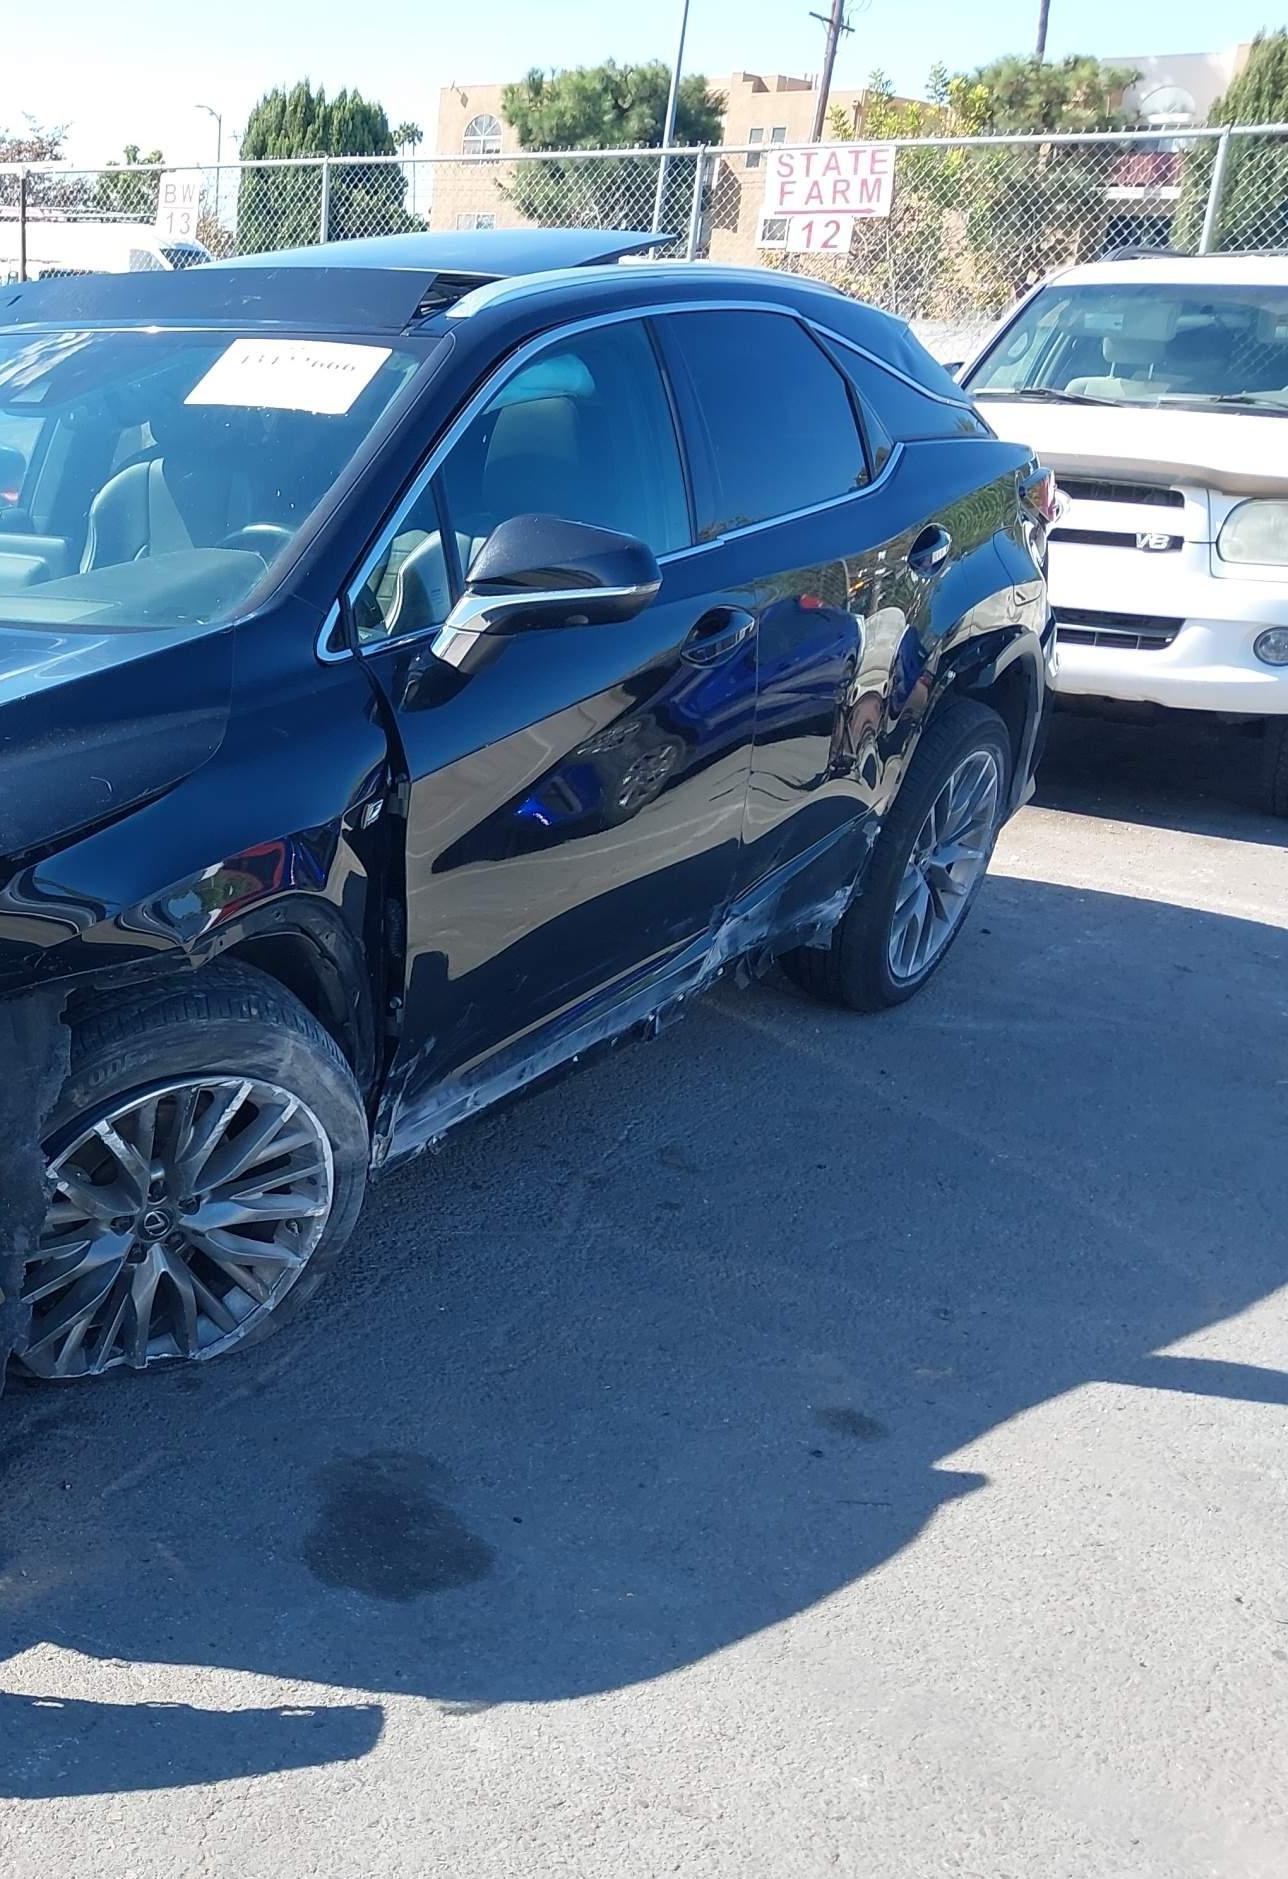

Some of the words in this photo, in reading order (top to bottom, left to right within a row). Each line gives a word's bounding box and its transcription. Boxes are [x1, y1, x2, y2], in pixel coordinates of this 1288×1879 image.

[776, 149, 889, 178] STATE
[164, 183, 196, 204] BW
[778, 177, 882, 206] FARM
[166, 211, 191, 235] 13
[801, 220, 841, 249] 12
